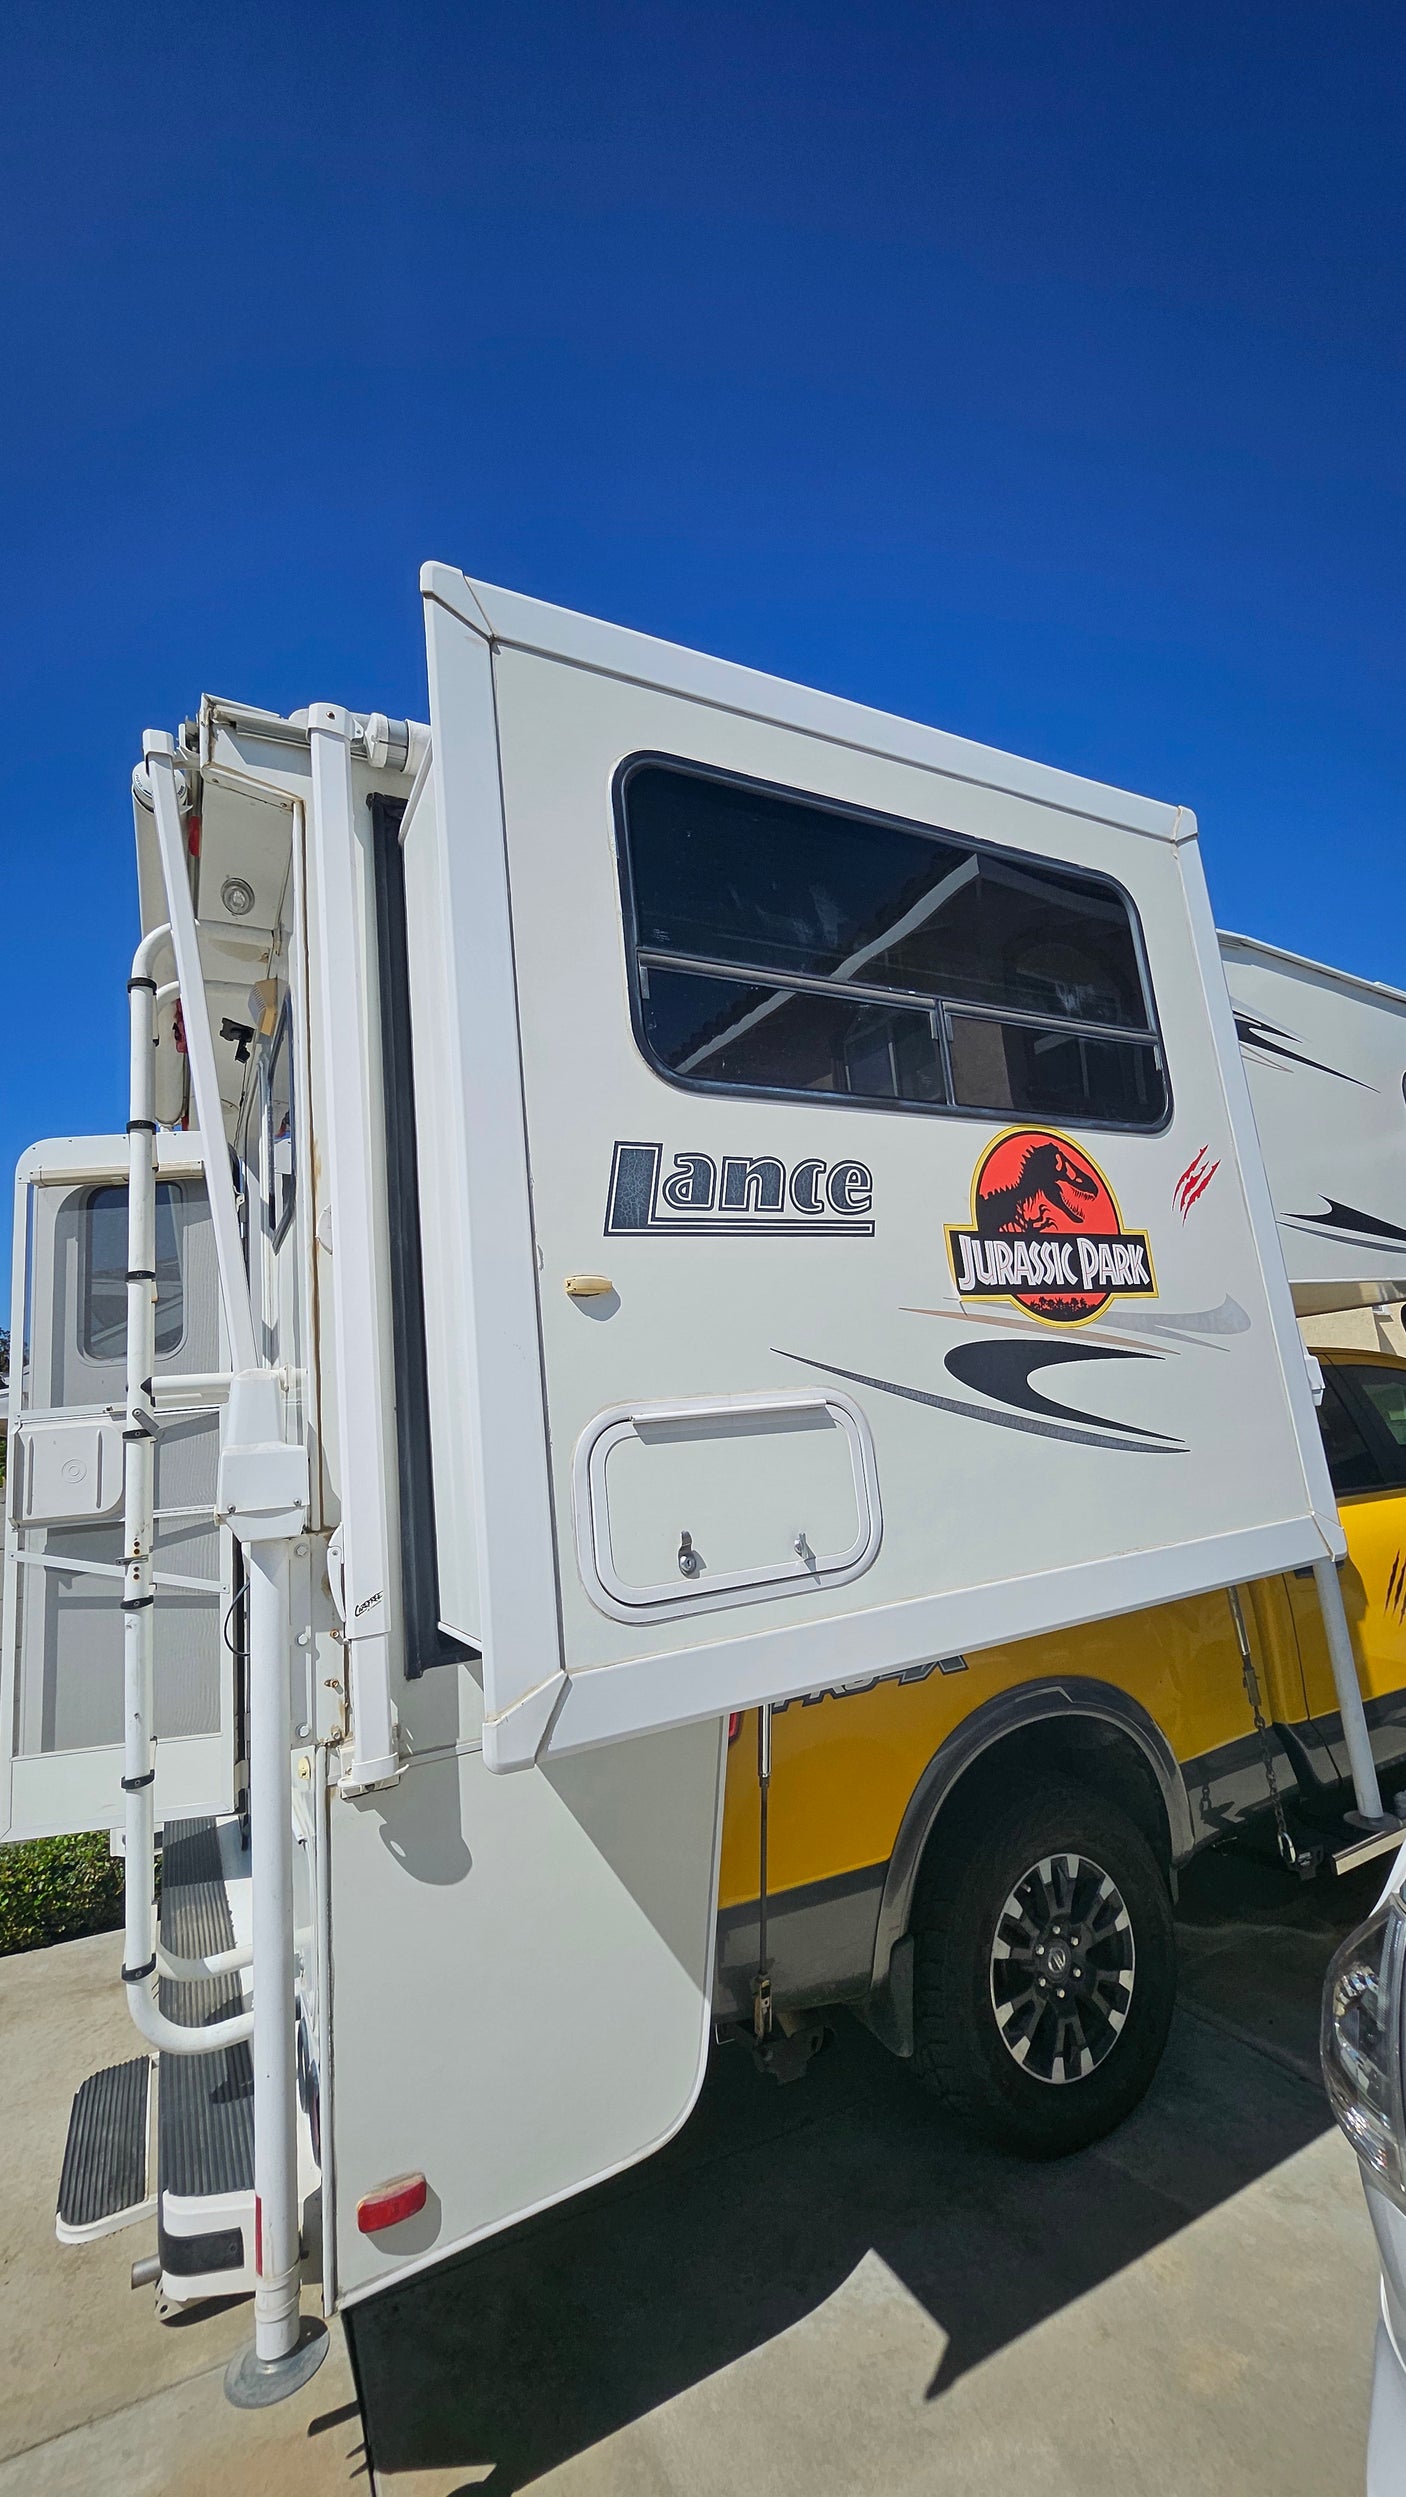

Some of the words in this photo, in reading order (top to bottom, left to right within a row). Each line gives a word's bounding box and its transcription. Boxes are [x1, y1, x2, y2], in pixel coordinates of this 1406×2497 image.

[603, 1140, 876, 1237] Lance
[958, 1234, 1079, 1291] JURASSIC
[1076, 1237, 1151, 1290] PARK
